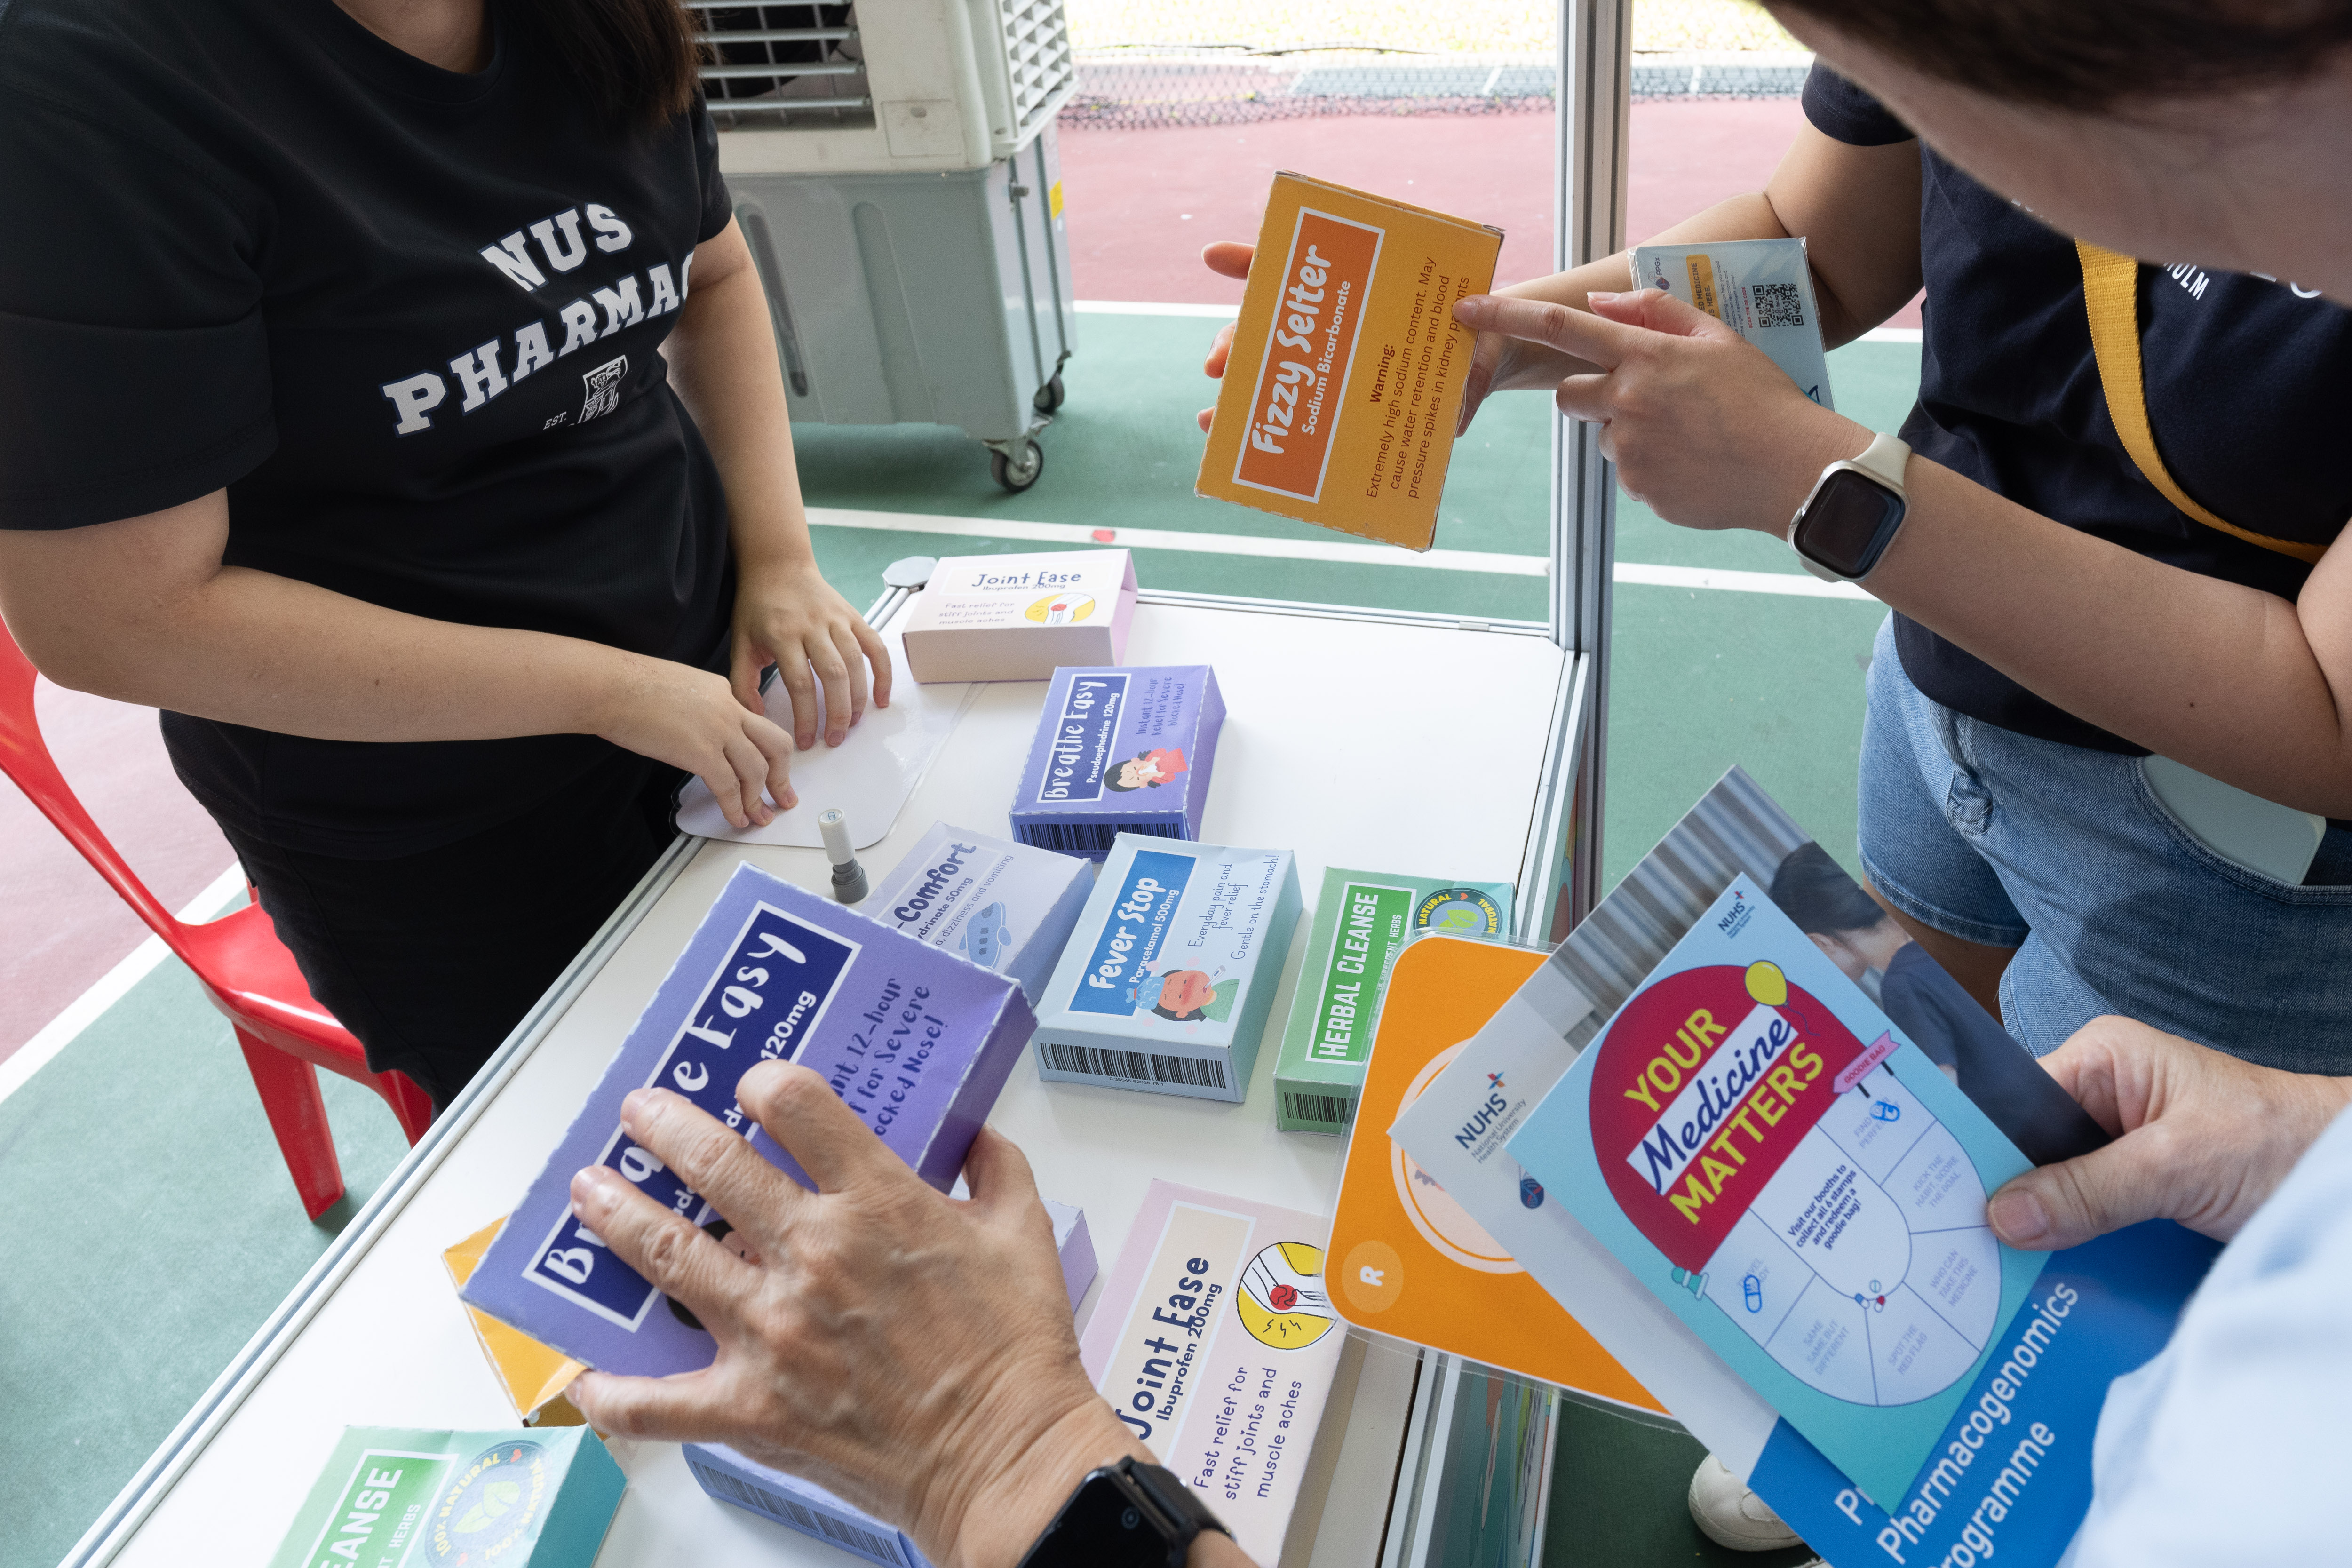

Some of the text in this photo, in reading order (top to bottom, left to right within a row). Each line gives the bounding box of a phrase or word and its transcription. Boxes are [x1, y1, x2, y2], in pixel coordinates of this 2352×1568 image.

[477, 202, 634, 293] NUS
[1691, 263, 1703, 299] MEDICINE
[1704, 285, 1713, 306] HERE.
[1252, 244, 1331, 454] Fizzy Selter
[1302, 280, 1351, 435] Sodium Bicarbonate
[1366, 256, 1437, 498] Extremely high sodium content. May
[1369, 344, 1395, 402] Warning:
[1391, 275, 1450, 489] cause water retention and blood
[1408, 277, 1469, 499] pressure spikes in kidney pants
[543, 411, 567, 430] EST.
[971, 571, 1081, 587] Joint Ease
[1044, 681, 1108, 798] Breathe Easy
[1086, 693, 1120, 783] Pseudoephedrine 120mg
[1135, 706, 1153, 735] Instant
[1151, 677, 1172, 736] Relief for Severe
[897, 842, 977, 929] -Comfort
[942, 854, 1014, 939] dizziness and vomiting
[946, 876, 973, 903] 50mg
[1187, 864, 1232, 947] Everyday pain and
[1212, 883, 1248, 930] fever relief
[1231, 855, 1279, 959] Gentle on the stomach!
[1389, 915, 1402, 938] HERBS
[1419, 894, 1452, 925] NATURAL
[1478, 898, 1498, 933] NATURAL
[1718, 901, 1745, 931] NUHS
[1089, 877, 1167, 989] Fever Stop
[1129, 889, 1180, 983] Paracetamol 500mg
[1337, 892, 1379, 974] CLEANSE
[685, 931, 807, 1050] Easy
[761, 990, 817, 1061] 120mg
[847, 978, 902, 1058] 12-hour
[1319, 985, 1361, 1057] HERBAL
[857, 1068, 884, 1098] for
[874, 986, 930, 1063] Severe
[874, 1014, 948, 1136] ocked Nose!
[1624, 1008, 1727, 1113] YOUR
[1844, 1045, 1886, 1084] GOODIE BAG
[1455, 1093, 1507, 1149] NUHS
[1471, 1099, 1526, 1158] National University
[1642, 1018, 1792, 1195] Medicine
[1669, 1043, 1824, 1225] MATTERS
[1788, 1165, 1846, 1235] Visit our booths to
[1797, 1218, 1820, 1247] collect
[1817, 1205, 1828, 1220] all
[1831, 1170, 1856, 1202] stamps
[1813, 1226, 1827, 1245] and
[1825, 1195, 1851, 1228] redeem
[1824, 1199, 1862, 1250] goodie bag!
[1359, 1266, 1384, 1287] R
[1115, 1257, 1210, 1440] Joint Ease
[1156, 1283, 1223, 1421] Ibuprofen 200mg
[1193, 1367, 1247, 1488] Fast relief for
[1224, 1368, 1277, 1500] stiff joints and
[1257, 1381, 1302, 1497] muscle aches
[1876, 1283, 2079, 1565] Pharmacogenomics
[388, 1504, 421, 1548] HERBS
[434, 1453, 501, 1557] 100% NATURAL
[1926, 1422, 2055, 1568] ogramme
